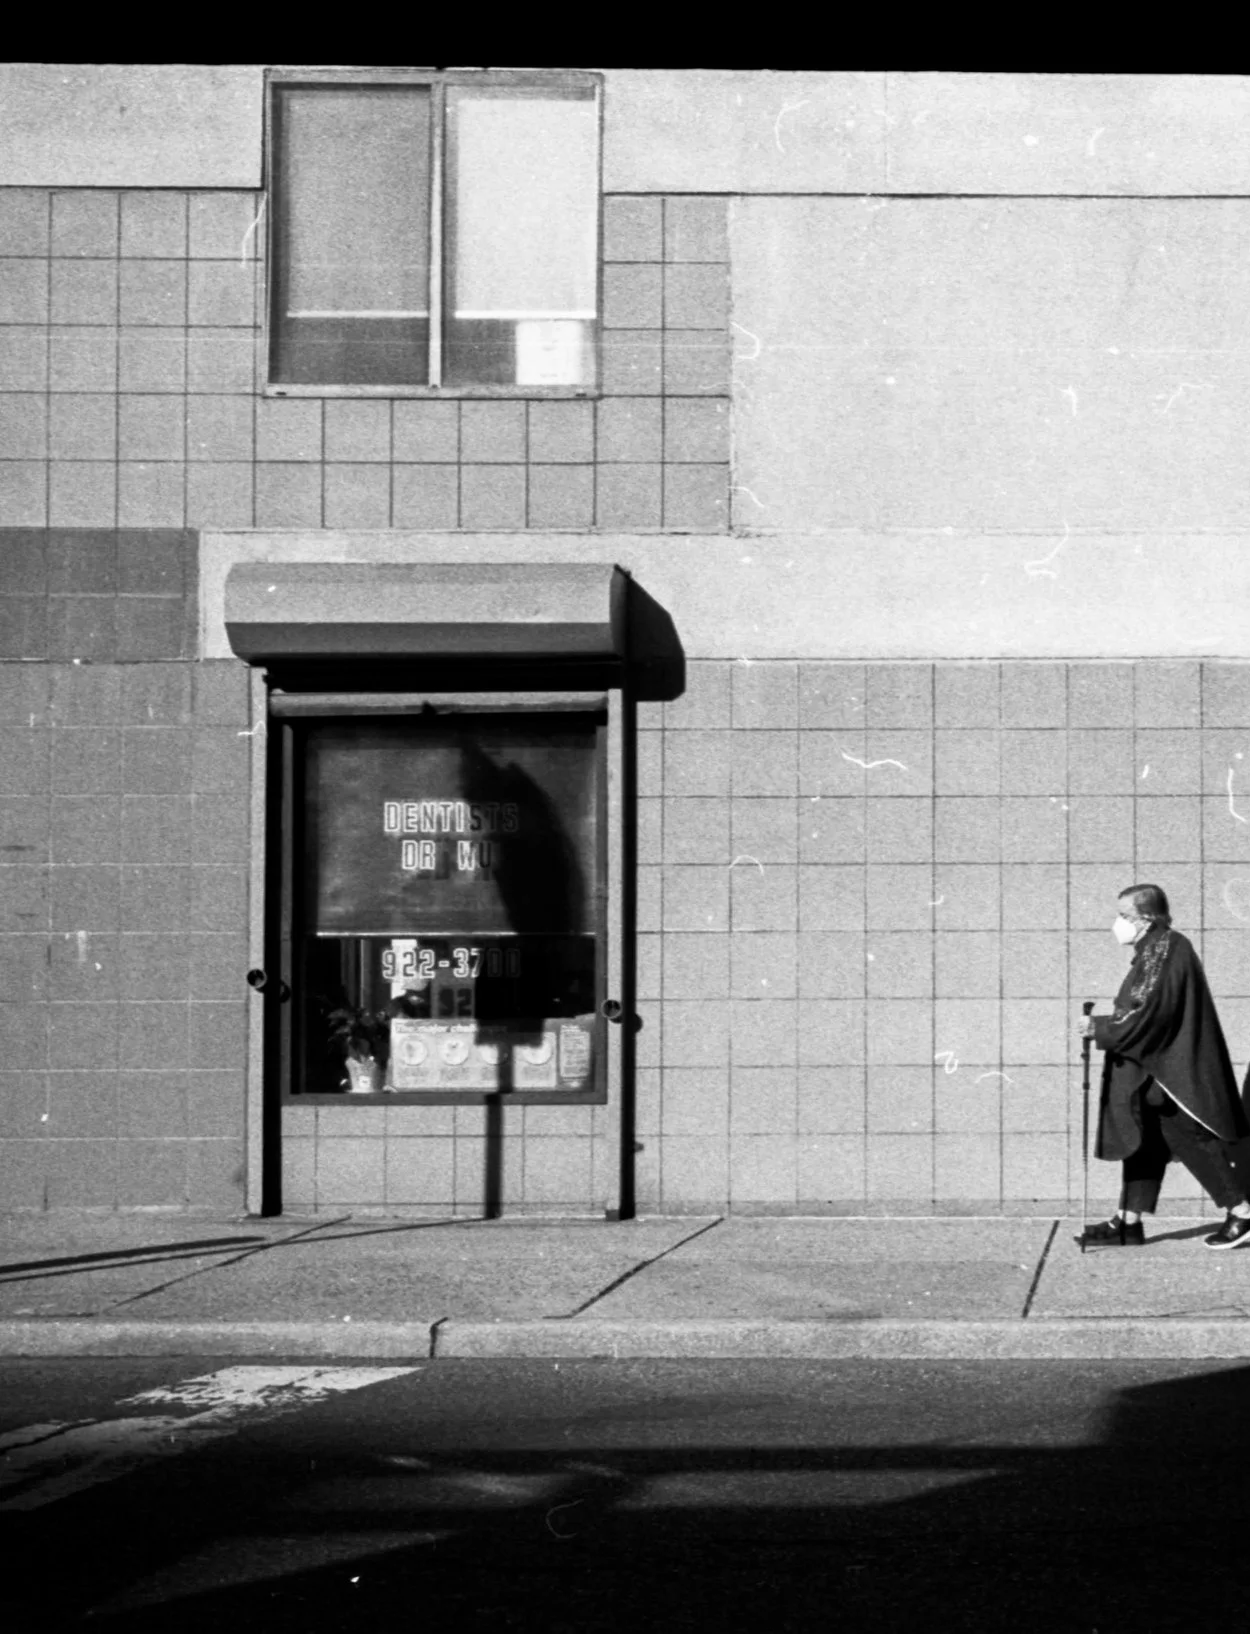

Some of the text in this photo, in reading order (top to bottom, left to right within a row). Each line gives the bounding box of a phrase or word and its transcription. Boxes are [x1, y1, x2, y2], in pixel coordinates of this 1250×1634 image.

[383, 801, 519, 833] DENTISTS
[401, 839, 493, 871] DR WU
[381, 947, 521, 979] 922-3700
